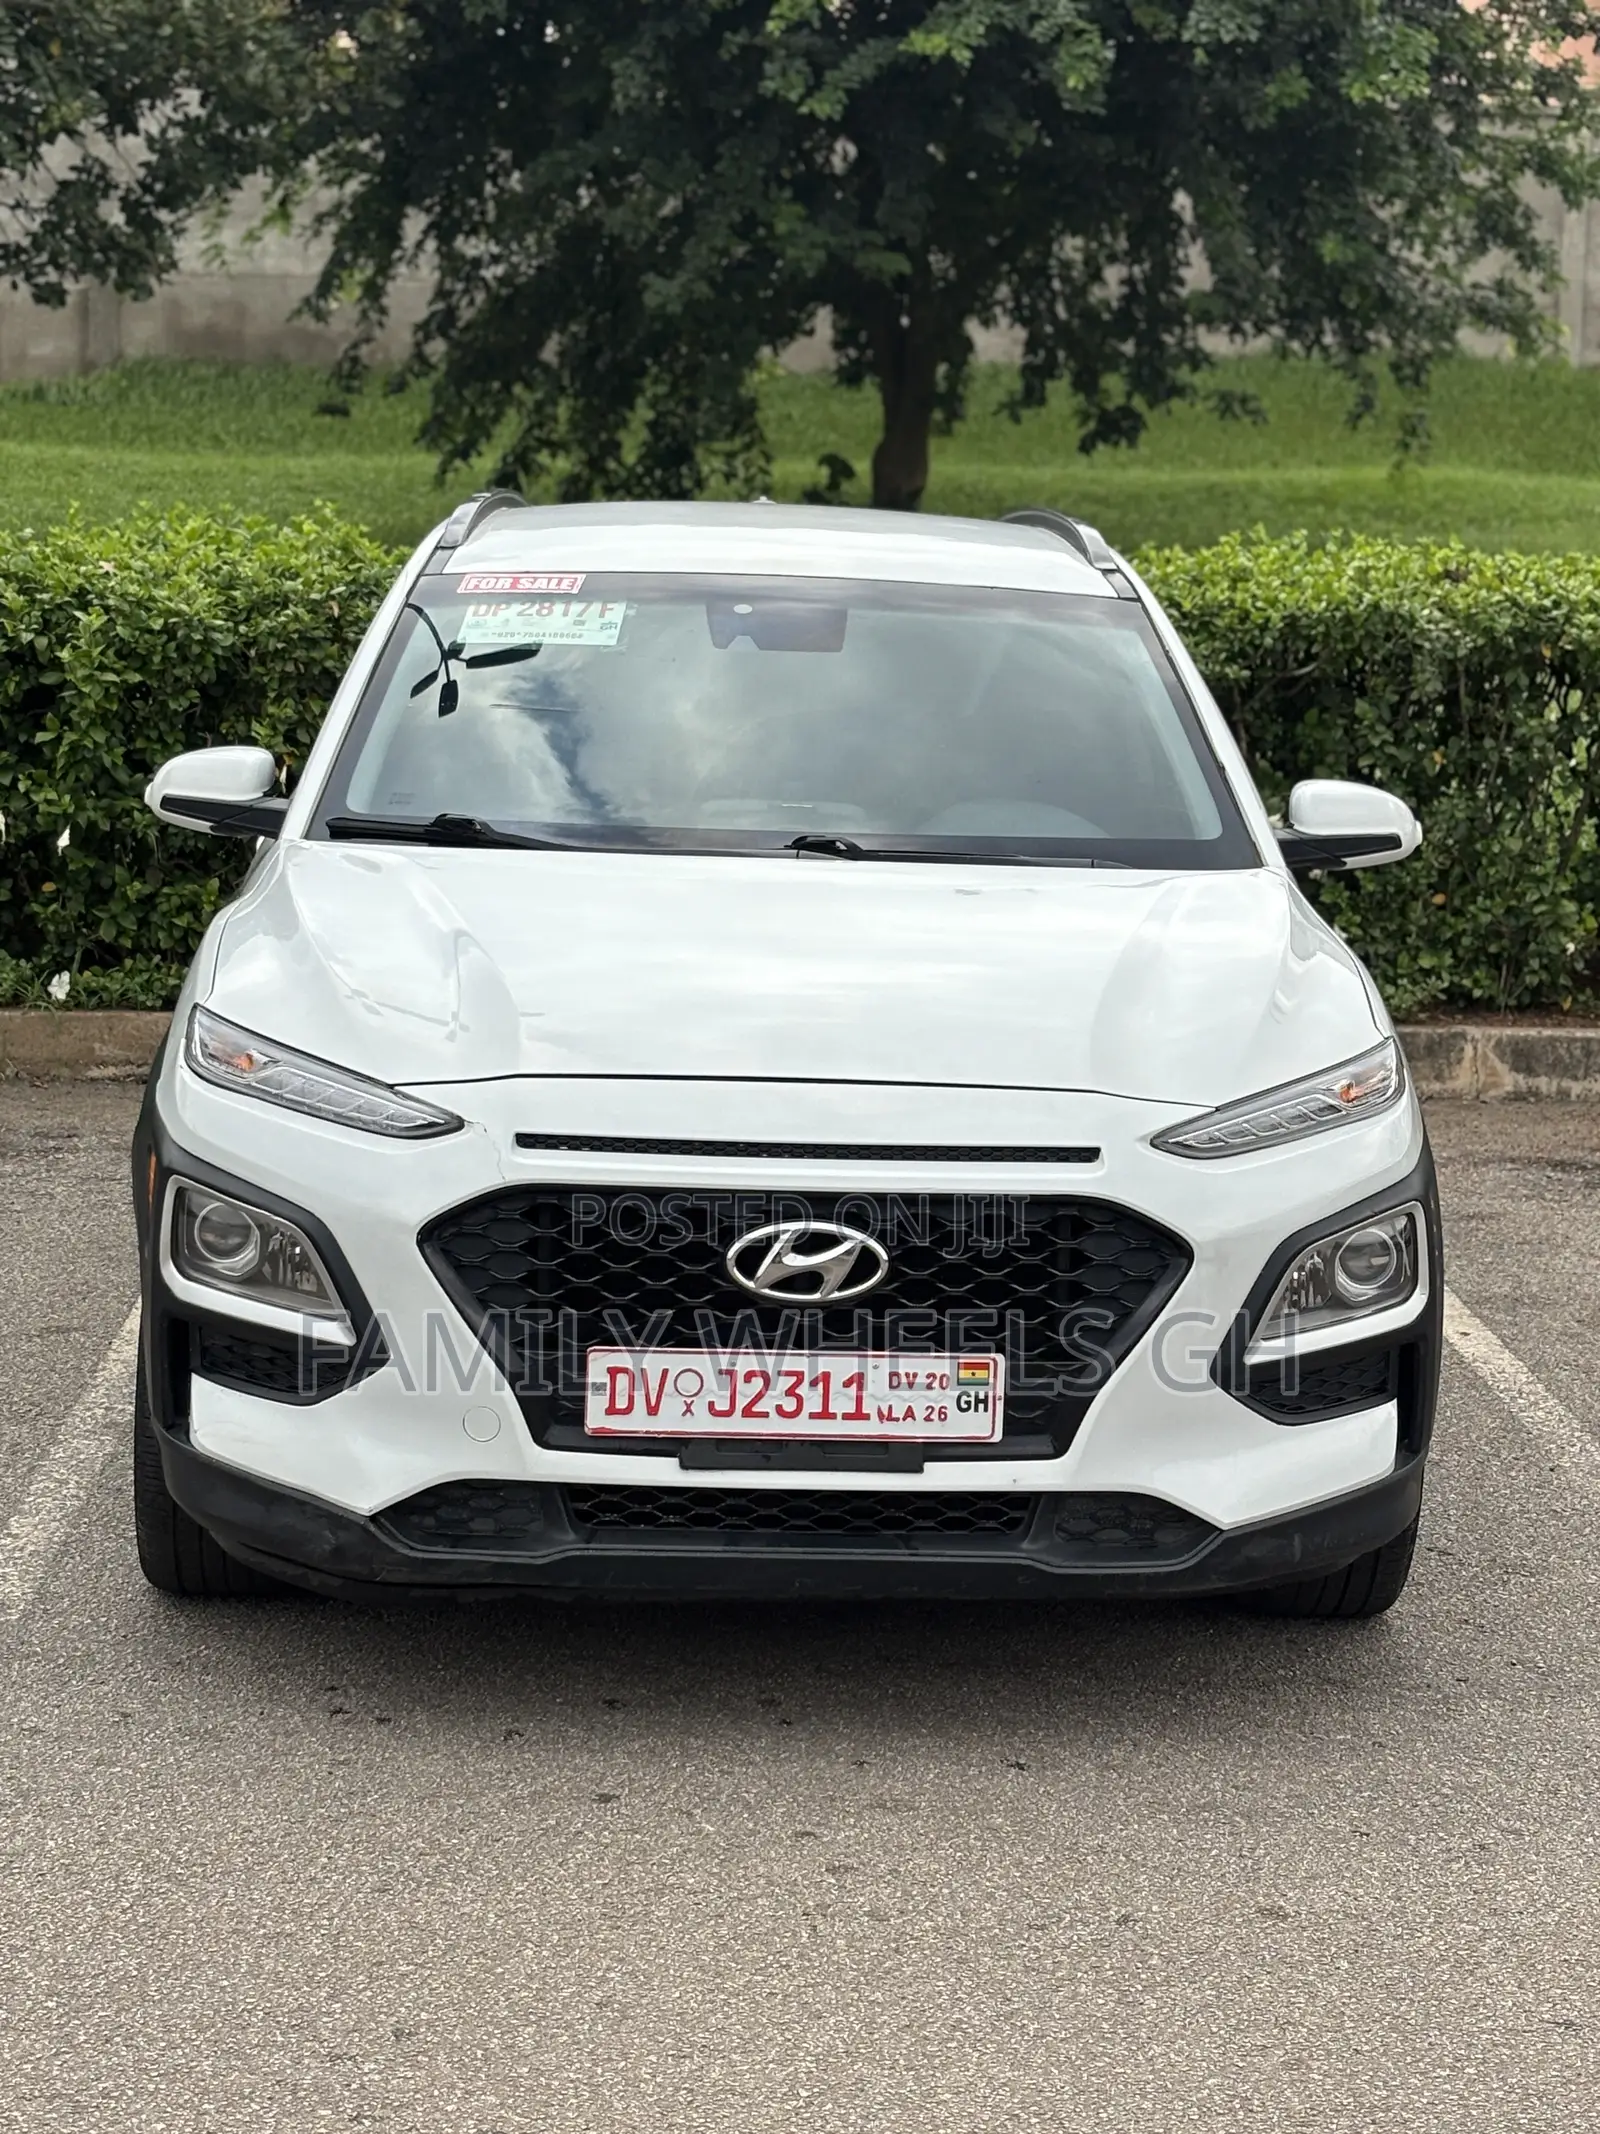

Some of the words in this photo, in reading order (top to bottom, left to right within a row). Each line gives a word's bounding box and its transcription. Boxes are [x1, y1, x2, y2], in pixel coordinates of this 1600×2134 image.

[467, 577, 511, 590] FOR
[517, 577, 575, 590] SALE
[472, 601, 512, 618] DP
[516, 600, 593, 618] 2817
[598, 601, 618, 619] F
[888, 1371, 918, 1390] DV
[925, 1372, 950, 1391] 20
[605, 1366, 669, 1416] DV
[708, 1368, 870, 1421] J2311
[956, 1390, 989, 1413] GH
[923, 1405, 948, 1422] 26
